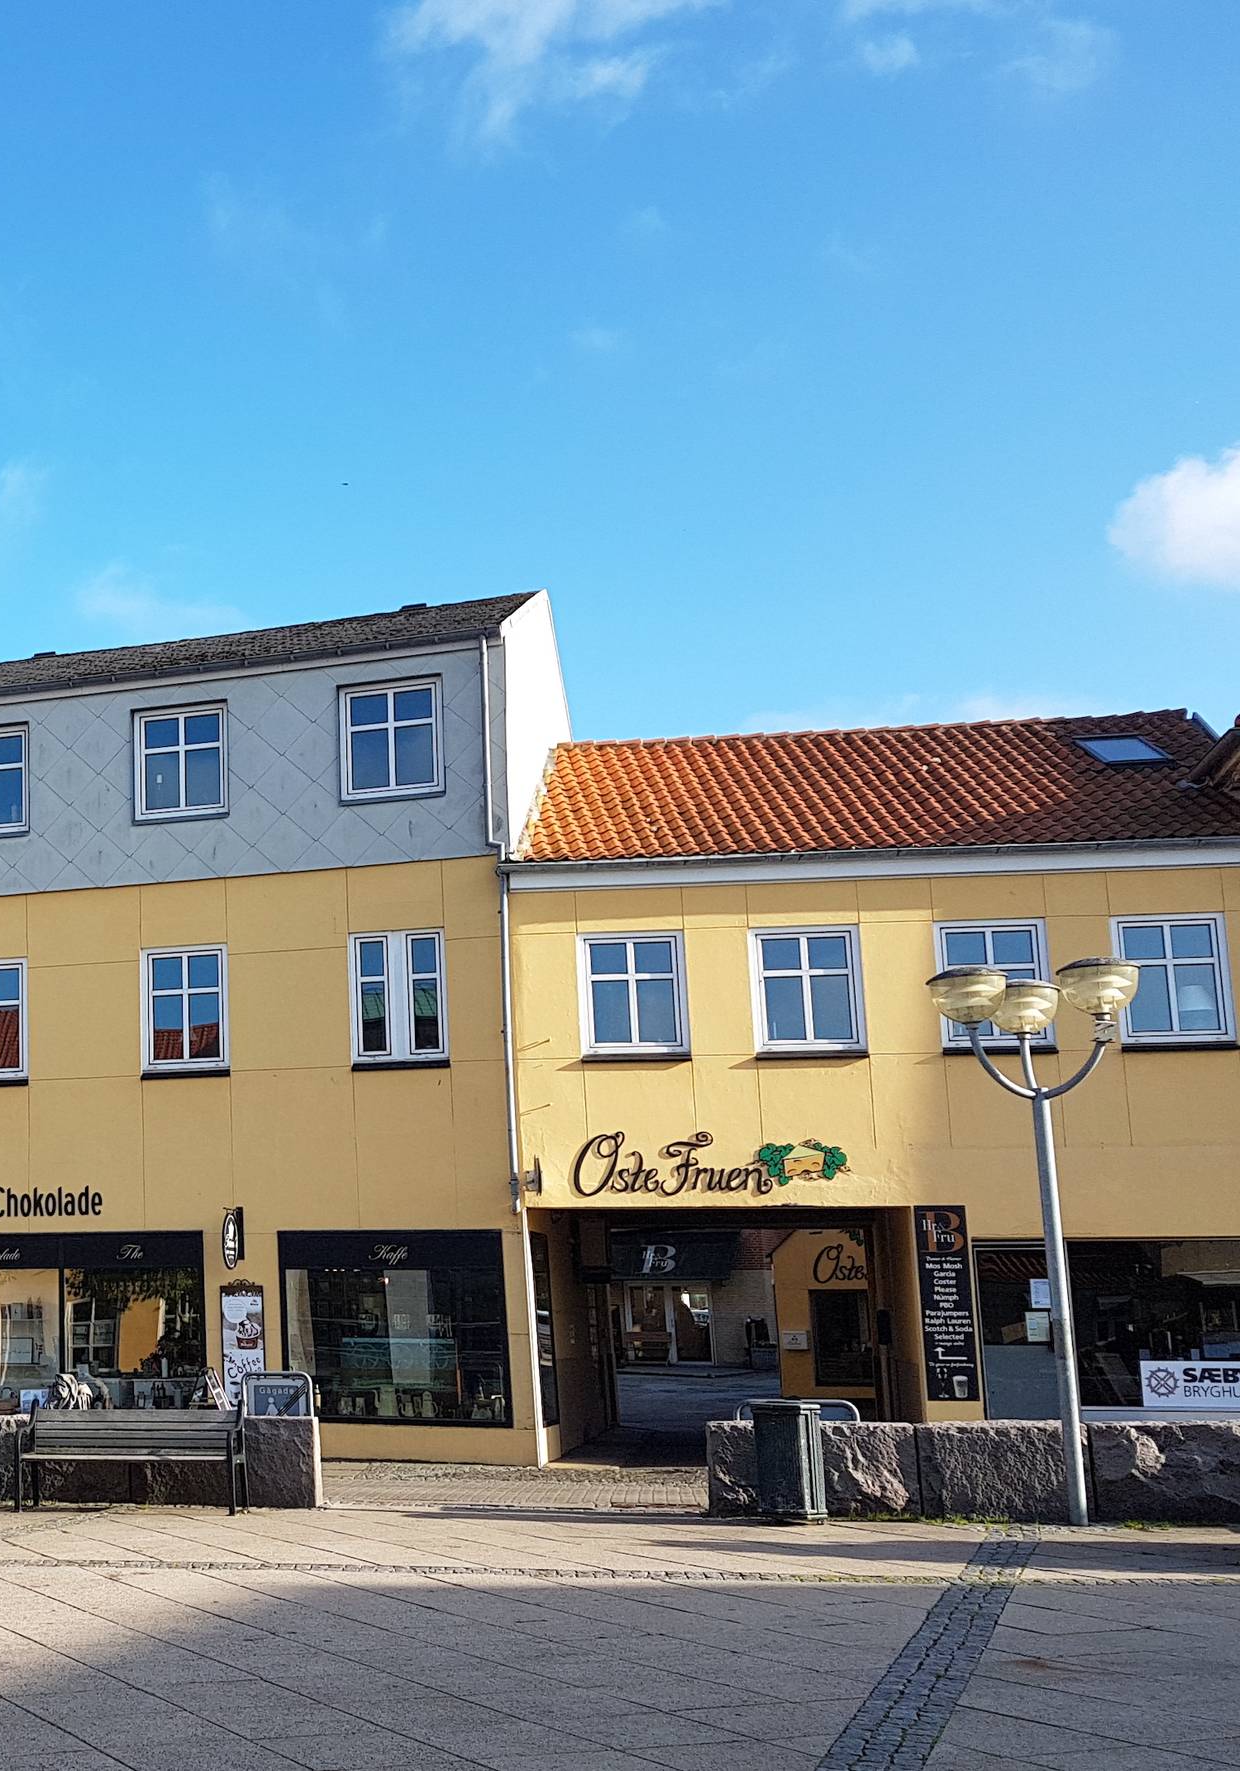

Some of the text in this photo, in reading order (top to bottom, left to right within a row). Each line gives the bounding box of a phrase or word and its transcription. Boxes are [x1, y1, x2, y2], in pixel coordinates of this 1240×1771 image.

[573, 1131, 773, 1196] Oste Fruen
[116, 1245, 144, 1260] The
[368, 1244, 408, 1265] Kaffe
[924, 1317, 945, 1325] Ralph
[1182, 1367, 1240, 1384] SÆB
